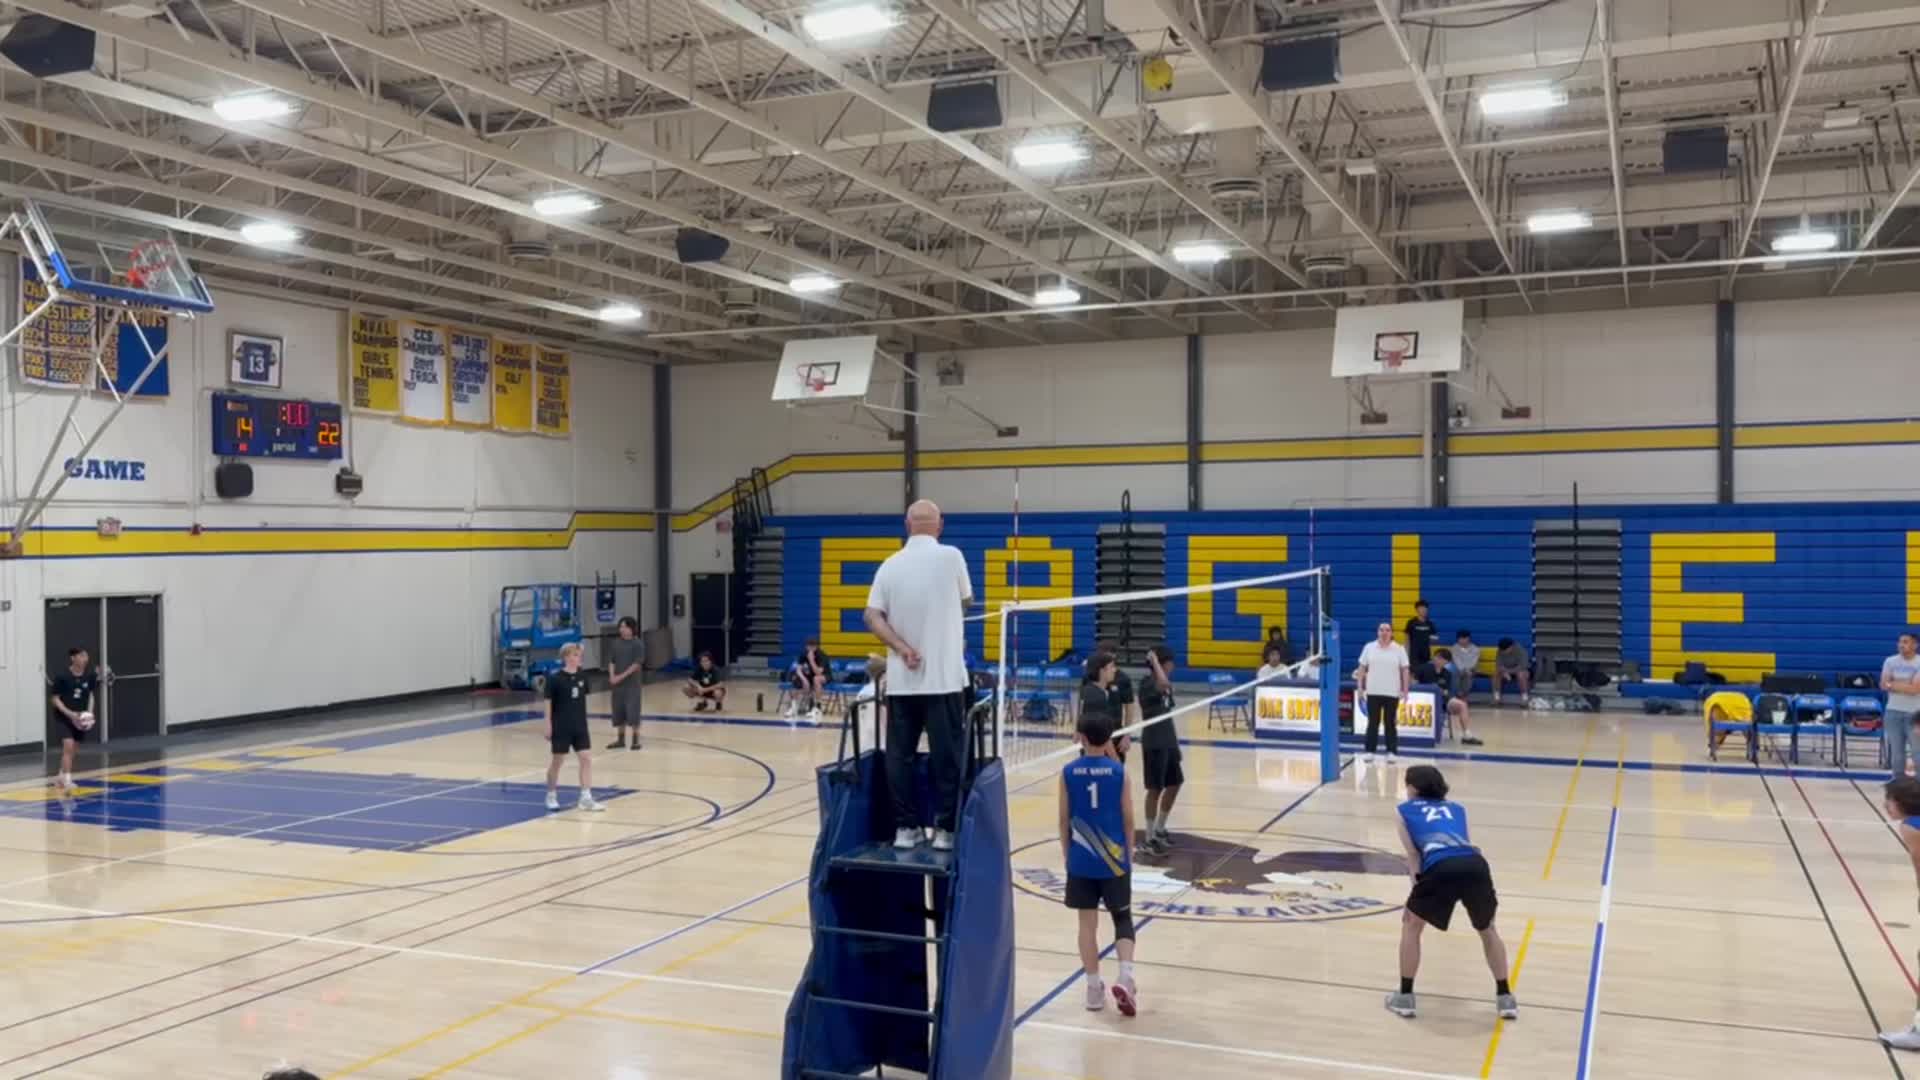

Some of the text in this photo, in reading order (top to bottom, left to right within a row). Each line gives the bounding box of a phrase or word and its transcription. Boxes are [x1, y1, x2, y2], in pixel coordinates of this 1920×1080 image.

[249, 355, 265, 373] 13
[410, 369, 438, 384] TRACK
[236, 417, 253, 439] 14
[318, 421, 340, 445] 22
[272, 442, 296, 453] period
[64, 457, 146, 481] GAME
[1257, 697, 1321, 721] OAK GROV
[1087, 782, 1098, 808] 1
[1421, 806, 1453, 823] 21
[1138, 897, 1385, 917] THE EAGLES
